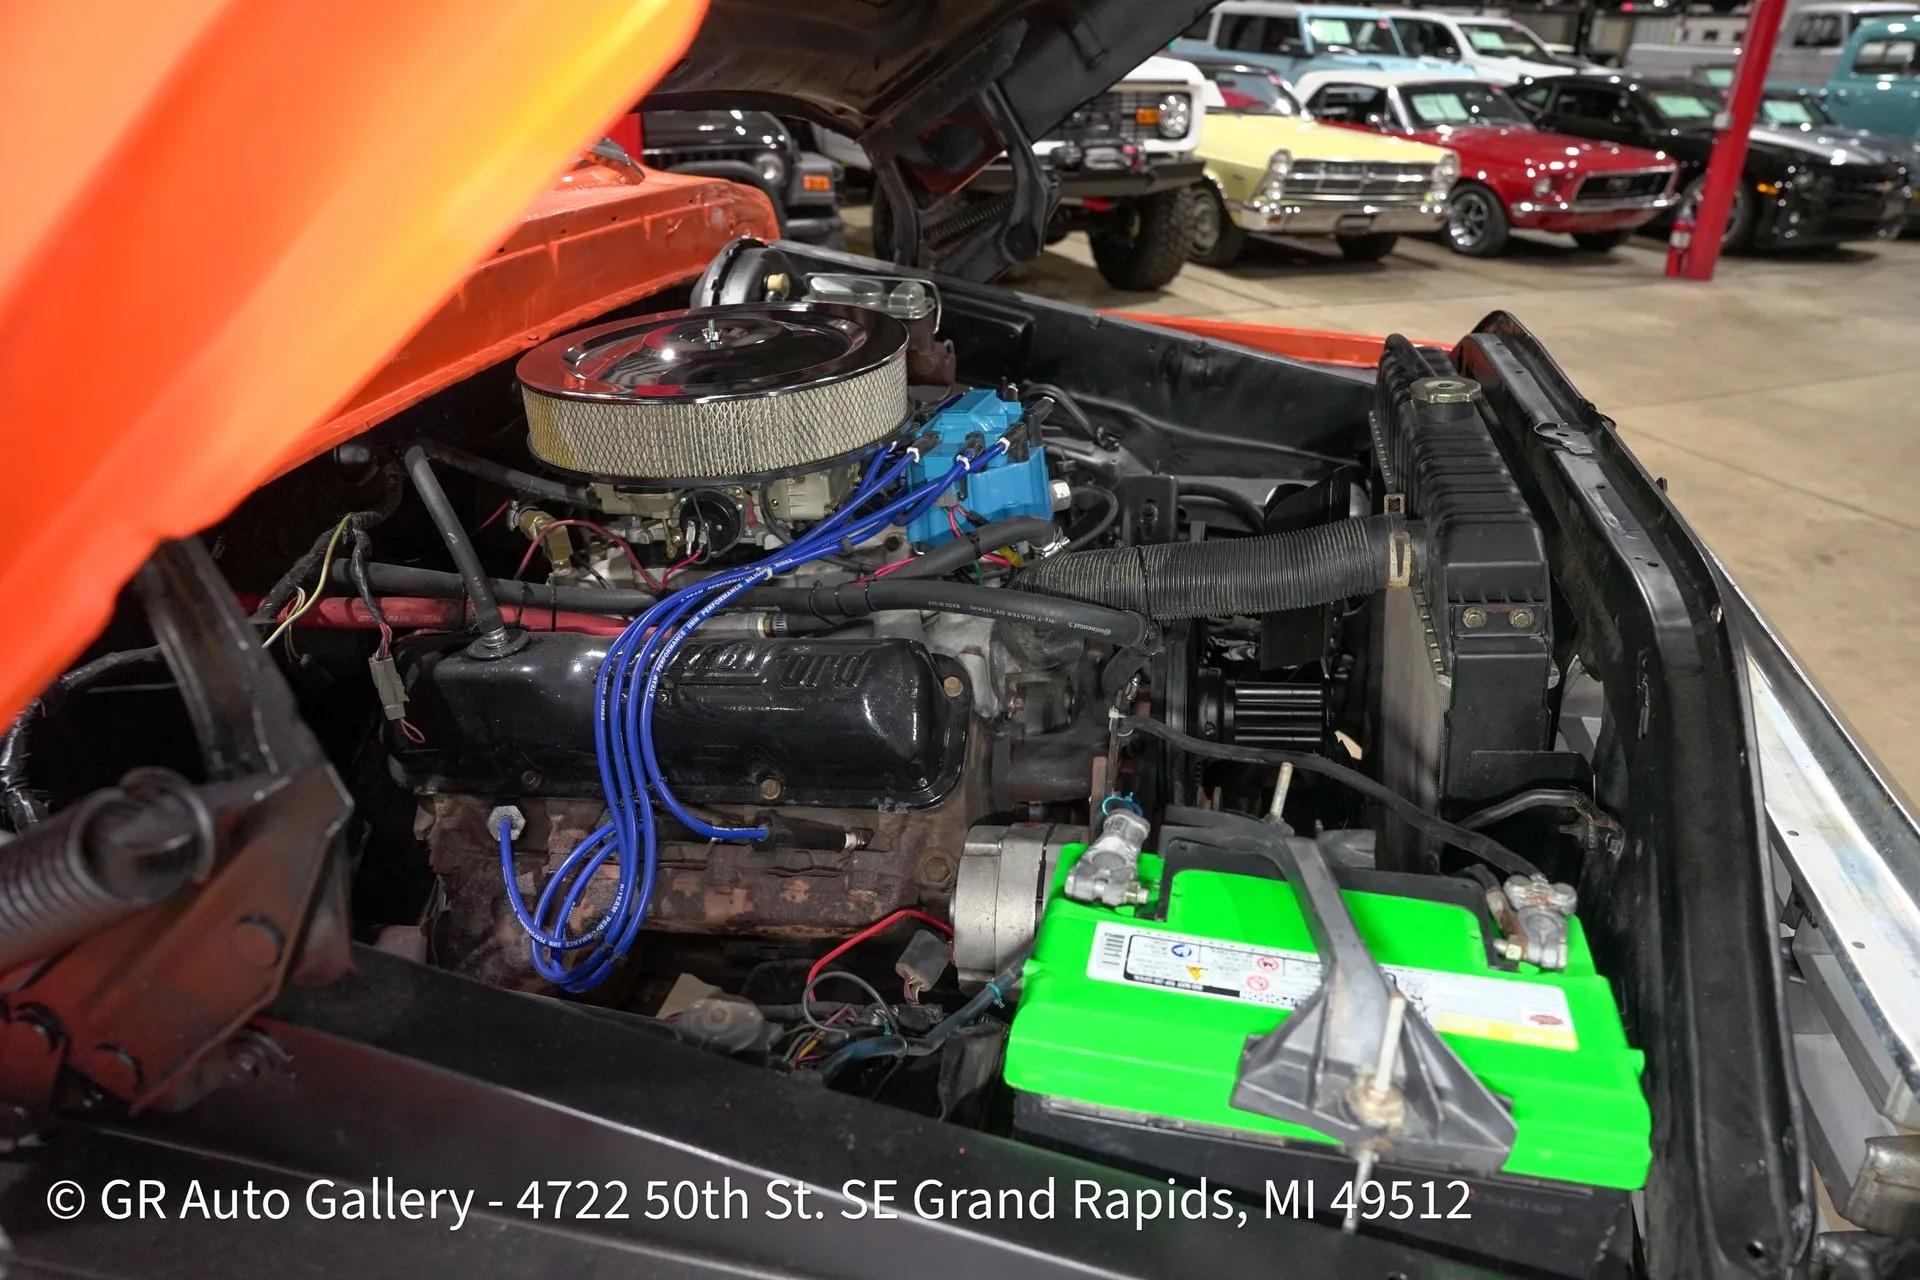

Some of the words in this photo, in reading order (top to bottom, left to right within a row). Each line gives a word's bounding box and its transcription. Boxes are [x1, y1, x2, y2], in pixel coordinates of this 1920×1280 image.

[1006, 610, 1037, 622] HEATER
[648, 673, 660, 699] A-TEAM
[656, 629, 687, 673] PERFORMANCE
[700, 582, 744, 617] PERFORMANCE
[610, 882, 625, 914] A-TEAM
